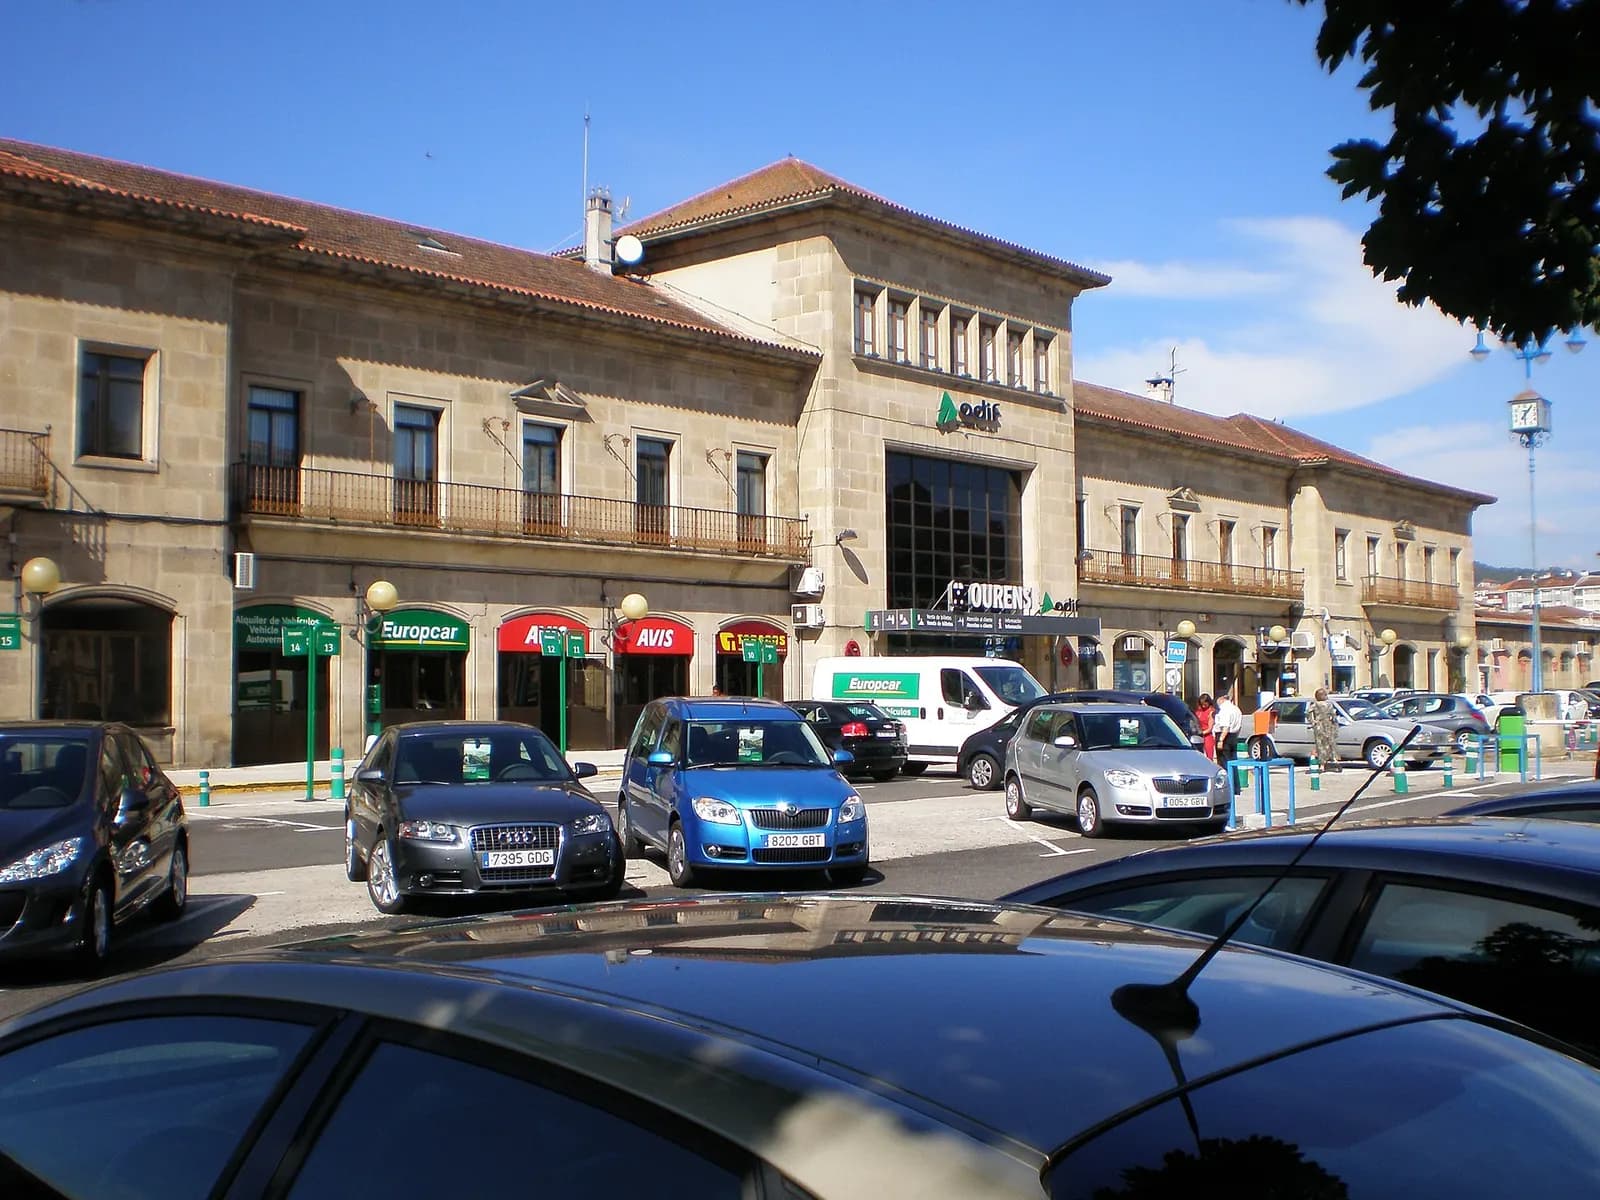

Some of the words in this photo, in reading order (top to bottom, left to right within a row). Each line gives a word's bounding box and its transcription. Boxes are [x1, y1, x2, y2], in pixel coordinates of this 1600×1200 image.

[235, 615, 267, 625] Alquiler
[269, 616, 280, 625] de
[249, 625, 279, 634] Vehicle
[381, 621, 458, 644] Europcar
[1, 636, 12, 646] 15
[636, 628, 674, 647] AVIS
[290, 643, 301, 652] 14
[324, 643, 334, 652] 13
[547, 645, 555, 653] 12
[1168, 647, 1186, 656] TAXI
[849, 677, 902, 693] Europcar
[1169, 798, 1189, 807] 0052
[771, 836, 799, 847] 8202
[802, 835, 822, 846] GBT
[492, 853, 523, 865] 7395
[527, 851, 550, 864] GDG
